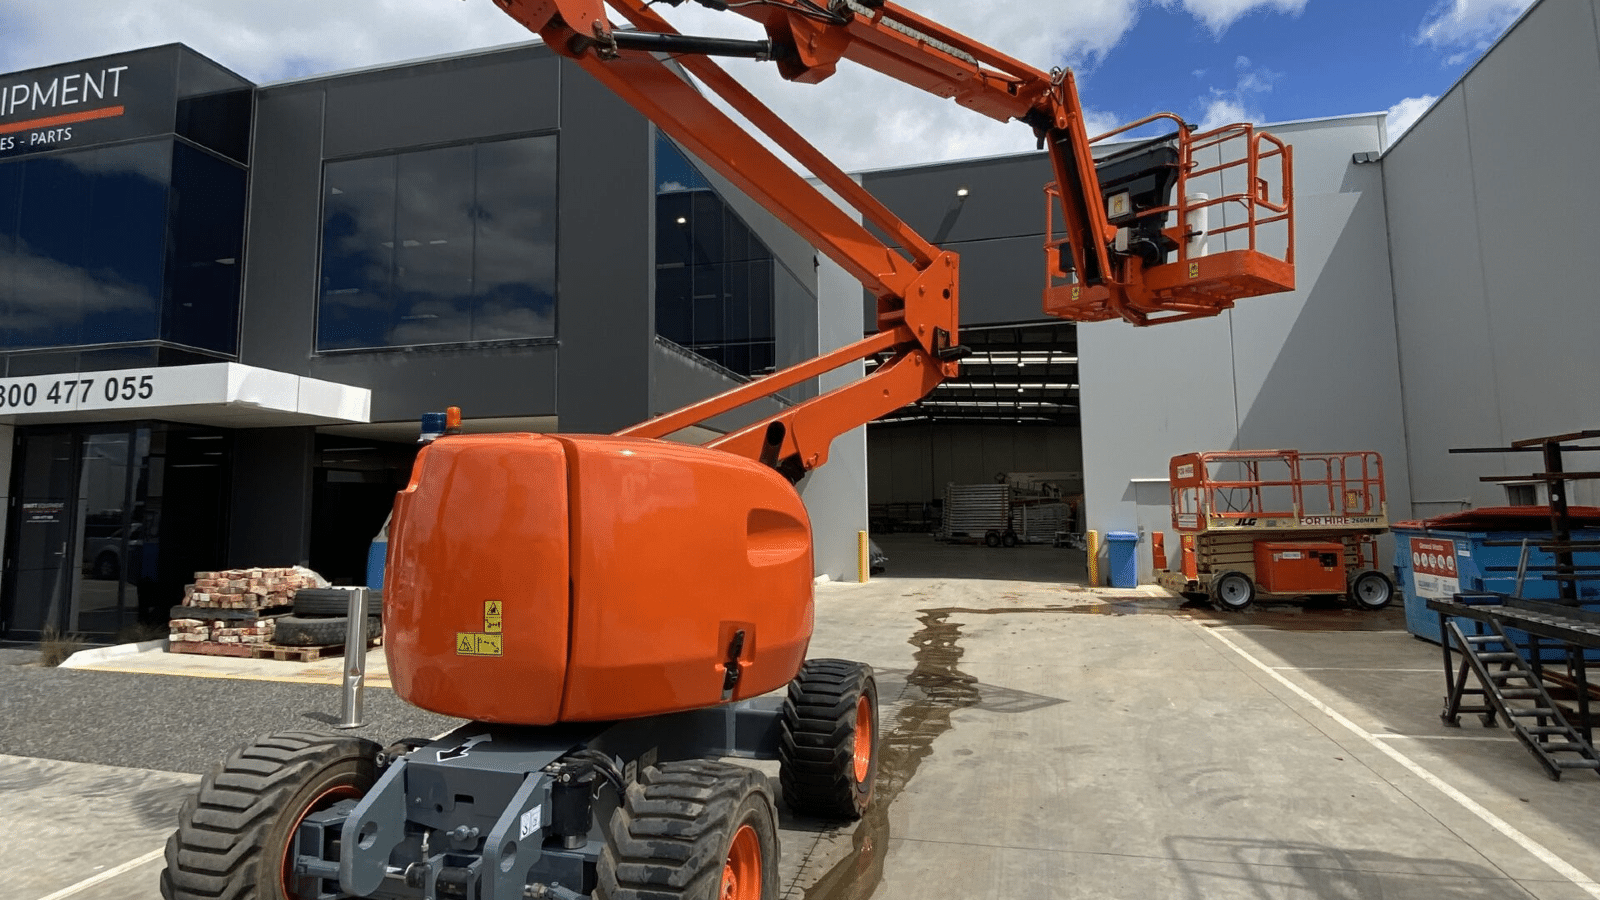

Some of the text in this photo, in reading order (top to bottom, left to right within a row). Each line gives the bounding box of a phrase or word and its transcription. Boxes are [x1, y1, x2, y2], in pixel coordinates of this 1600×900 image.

[1, 66, 128, 116] IPMENT
[30, 128, 72, 146] PARTS
[47, 379, 95, 404] 477
[104, 375, 153, 401] 055
[1235, 517, 1257, 526] JLG
[1299, 516, 1321, 525] FOR
[1324, 515, 1351, 525] HIRE
